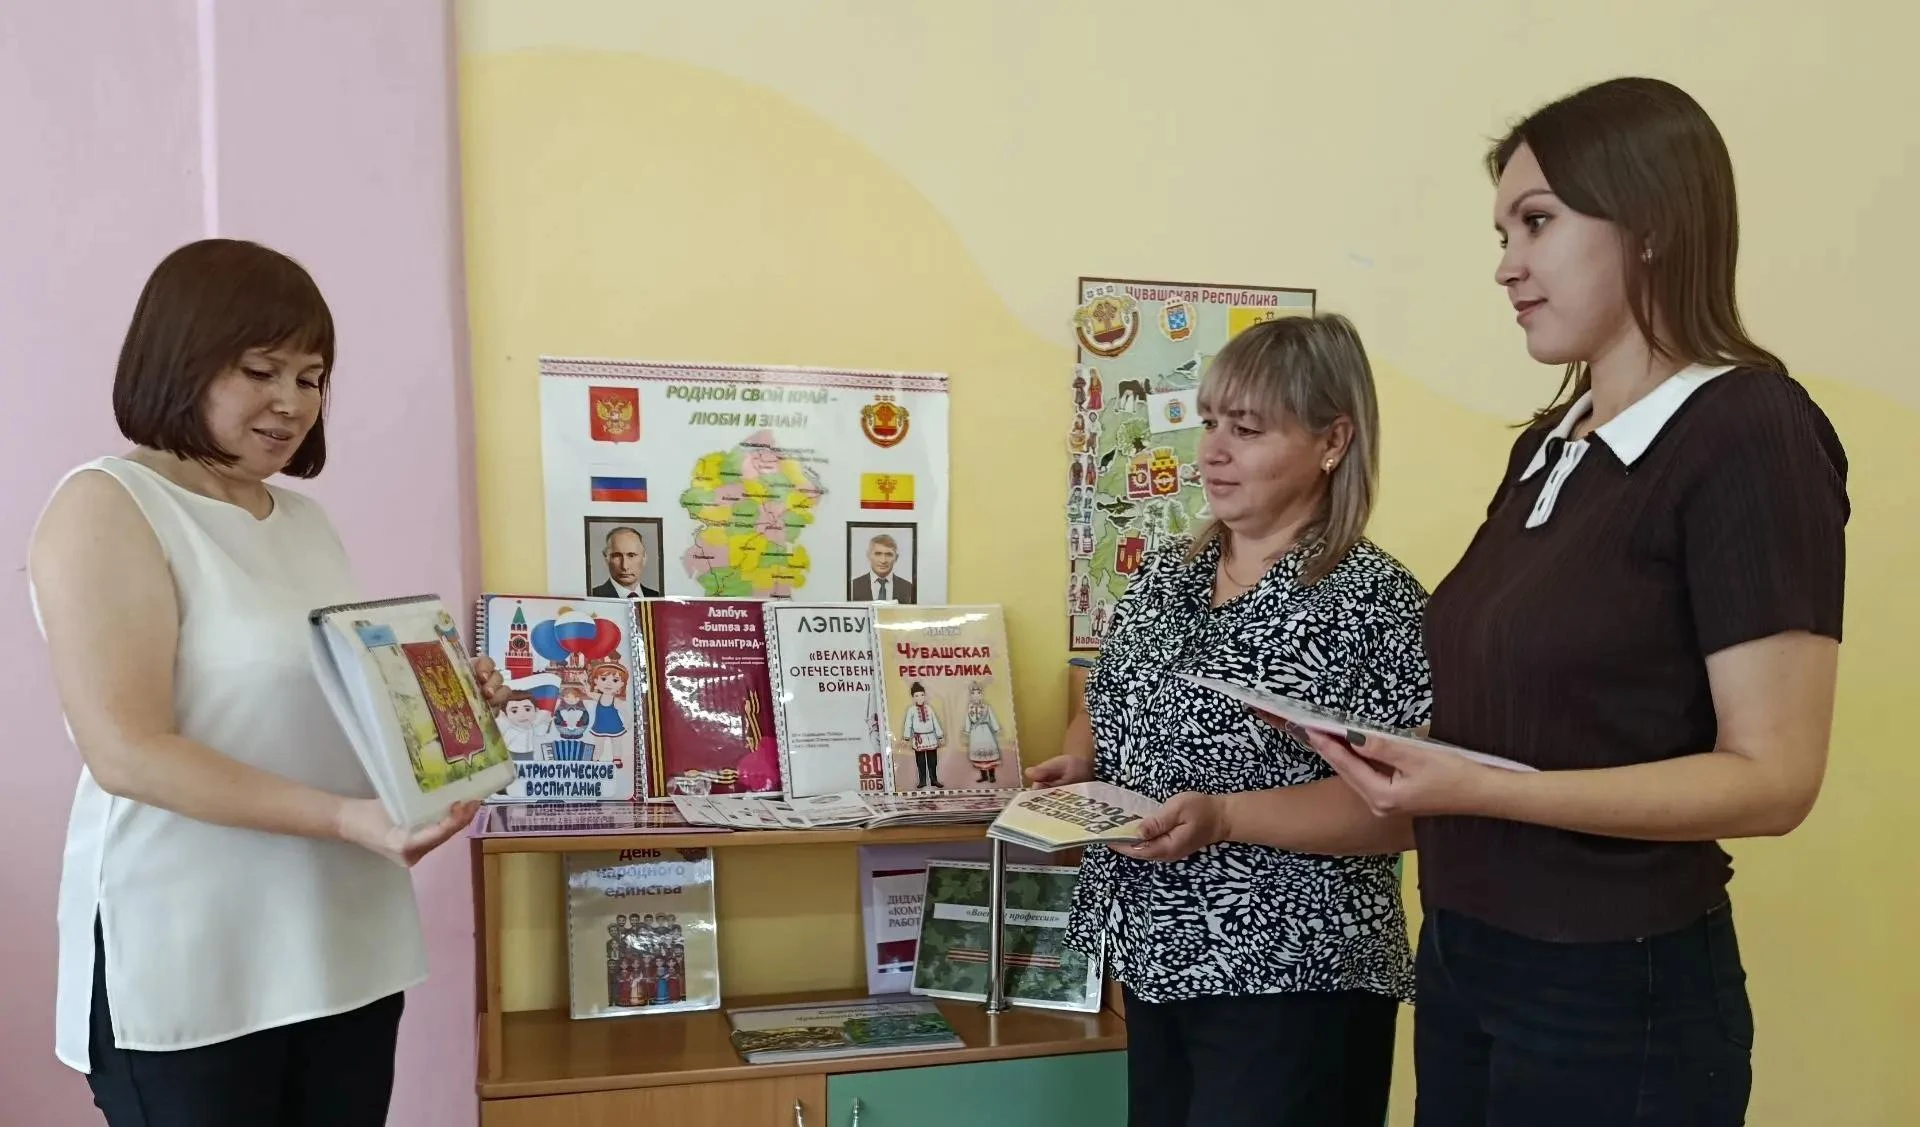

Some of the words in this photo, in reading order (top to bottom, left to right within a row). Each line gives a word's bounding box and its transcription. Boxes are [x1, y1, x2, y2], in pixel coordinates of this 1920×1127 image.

[1202, 289, 1278, 306] Республика
[666, 384, 737, 402] РОДНОЙ
[740, 386, 784, 402] СВОЙ
[688, 411, 741, 427] ЛЮБИ
[744, 413, 757, 427] И
[707, 606, 748, 620] Лэпбук
[698, 621, 741, 632] «Битва
[742, 624, 756, 632] за
[798, 616, 871, 633] ЛЭПБУ
[692, 637, 765, 650] Сталинград»
[809, 650, 873, 661] «ВЕЛИКАЯ
[899, 664, 993, 678] РЕСПУБЛИКА
[818, 679, 871, 692] ВОЙНА»
[514, 763, 614, 779] АТРИОТИЧЕСКОЕ
[859, 753, 883, 775] 80
[526, 780, 602, 797] ВОСПИТАНИЕ
[860, 779, 884, 791] ПОБ
[619, 848, 661, 861] День
[605, 885, 682, 898] единства
